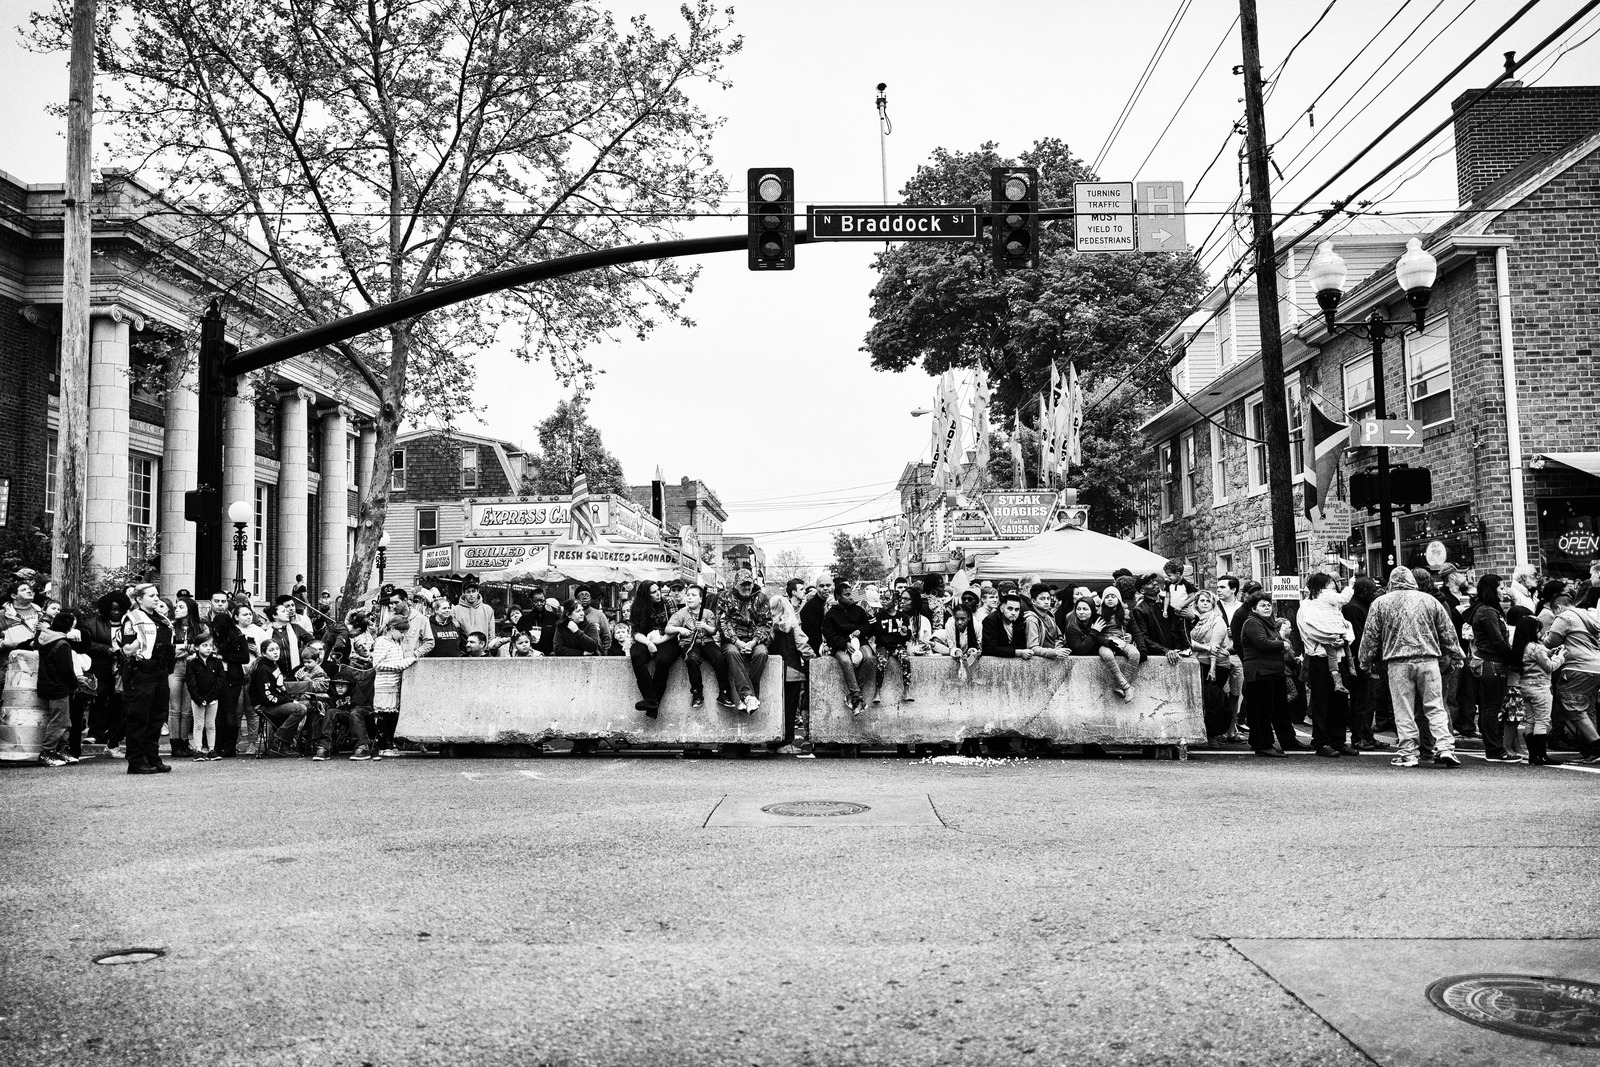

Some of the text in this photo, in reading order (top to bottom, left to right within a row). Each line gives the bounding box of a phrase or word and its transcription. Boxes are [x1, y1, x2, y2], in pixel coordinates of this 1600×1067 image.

[1087, 190, 1121, 198] TURNING
[1088, 201, 1120, 209] TRAFFIC
[1146, 186, 1176, 220] H
[823, 215, 832, 224] N
[840, 214, 942, 232] Braddock
[1091, 213, 1117, 222] MUST
[1079, 237, 1132, 245] PEDESTRIANS
[1365, 422, 1379, 441] P
[999, 496, 1040, 504] STEAK
[480, 506, 572, 526] EXPRESS CA
[993, 507, 1048, 515] HOAGIES
[1001, 525, 1040, 533] SAUSAGE
[1558, 536, 1600, 550] OPEN
[464, 546, 526, 558] GRILLED
[552, 550, 584, 561] FRESH
[585, 550, 632, 562] SQUEEZED
[424, 555, 451, 569] DRINKS
[465, 557, 513, 568] BREAST
[1273, 584, 1299, 592] PARKING
